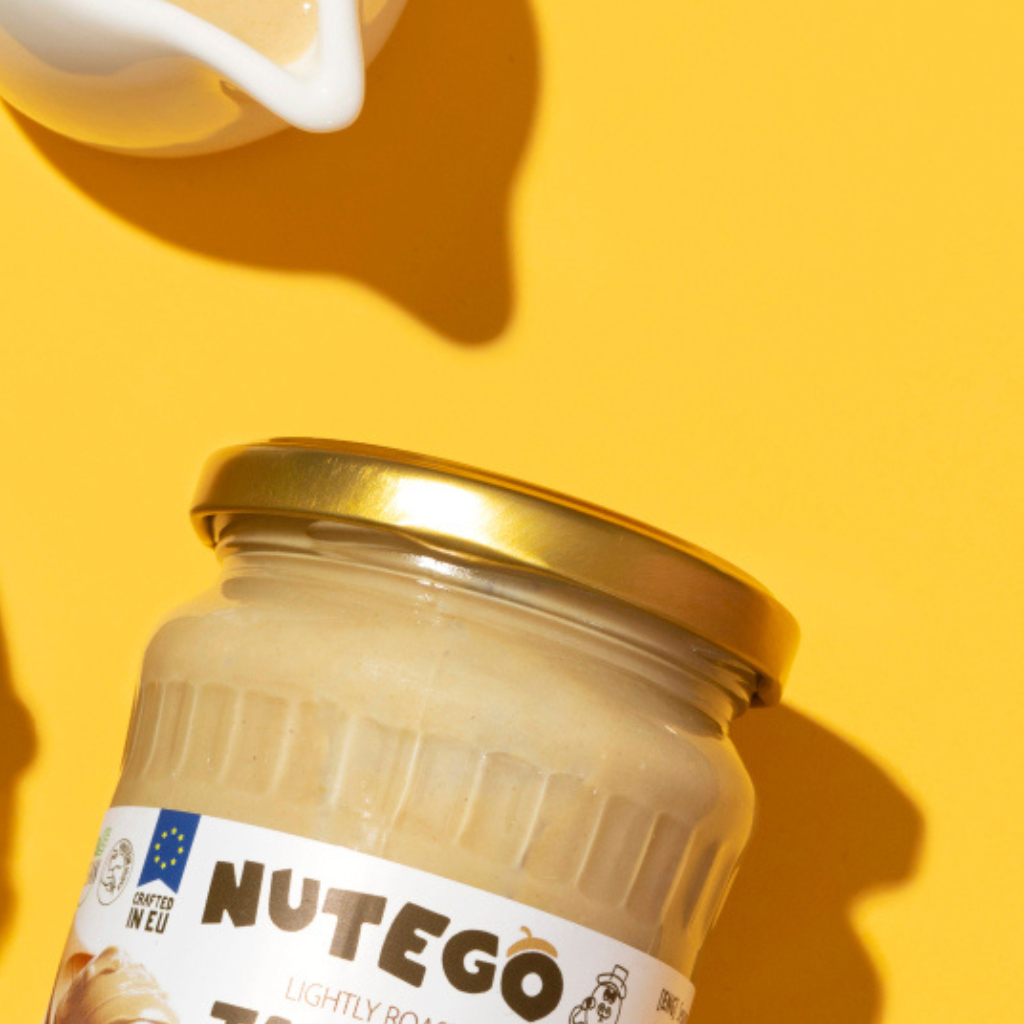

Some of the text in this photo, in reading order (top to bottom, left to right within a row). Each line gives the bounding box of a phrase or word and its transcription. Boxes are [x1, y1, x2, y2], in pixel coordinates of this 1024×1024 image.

[132, 891, 175, 911] CRAFTED
[125, 907, 170, 934] IN EU
[201, 860, 564, 1023] NUTEGO
[285, 977, 382, 1023] LIGHTLY
